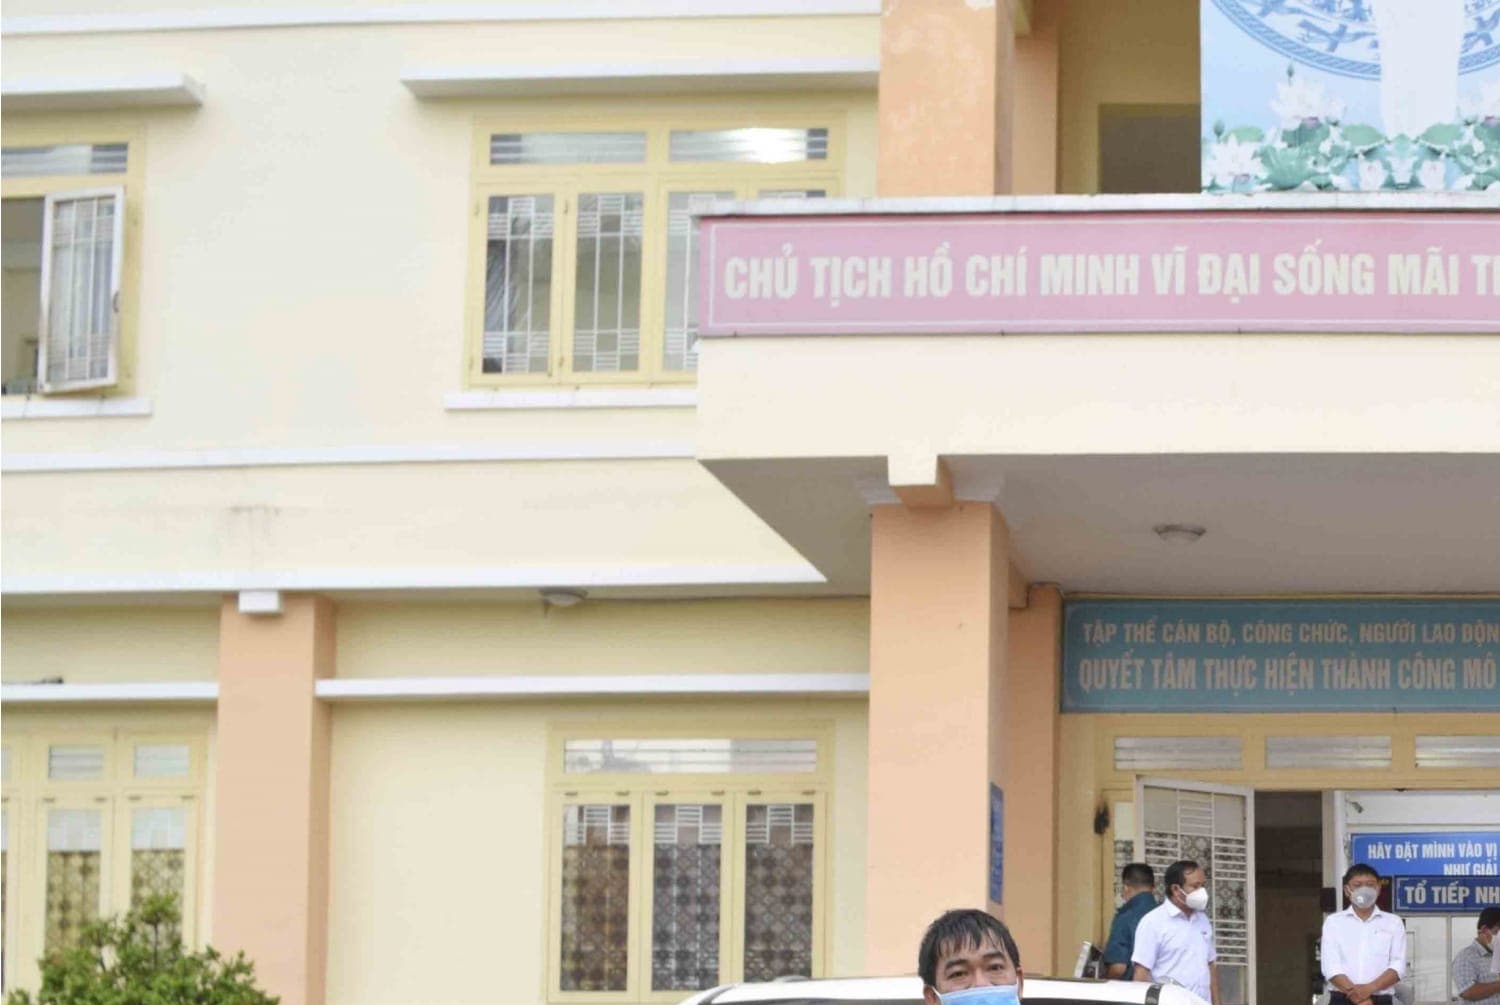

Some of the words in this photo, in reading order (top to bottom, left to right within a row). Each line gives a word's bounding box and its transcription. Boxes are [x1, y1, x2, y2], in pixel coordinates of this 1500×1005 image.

[724, 243, 798, 298] CHỦ
[810, 254, 891, 306] TỊCH
[903, 241, 953, 297] HỒ
[965, 246, 1026, 296] CHÍ
[1040, 253, 1138, 295] MINH
[1151, 245, 1187, 295] VĨ
[1197, 253, 1259, 303] ĐẠI
[1273, 239, 1373, 295] SỐNG
[1387, 246, 1459, 296] MÃI
[1083, 619, 1116, 646] TẬP
[1123, 616, 1158, 644] THỂ
[1162, 619, 1199, 644] CÁN
[1242, 619, 1292, 644] CÔNG
[1359, 619, 1416, 644] NGƯỜI
[1422, 623, 1455, 644] LAO
[1079, 648, 1145, 693] QUYẾT
[1151, 651, 1196, 690] TÂM
[1204, 654, 1256, 697] THỰC
[1264, 651, 1314, 696] HIỆN
[1321, 652, 1391, 690] THÀNH
[1400, 652, 1455, 690] CÔNG
[1463, 652, 1495, 690] MÔ
[1368, 840, 1391, 859] HÃY
[1395, 840, 1419, 863] ĐẶT
[1422, 840, 1456, 859] MÌNH
[1460, 840, 1482, 858] VÀO
[1485, 843, 1498, 861] VỊ
[1404, 879, 1427, 904] TỔ
[1432, 881, 1470, 904] TIẾP
